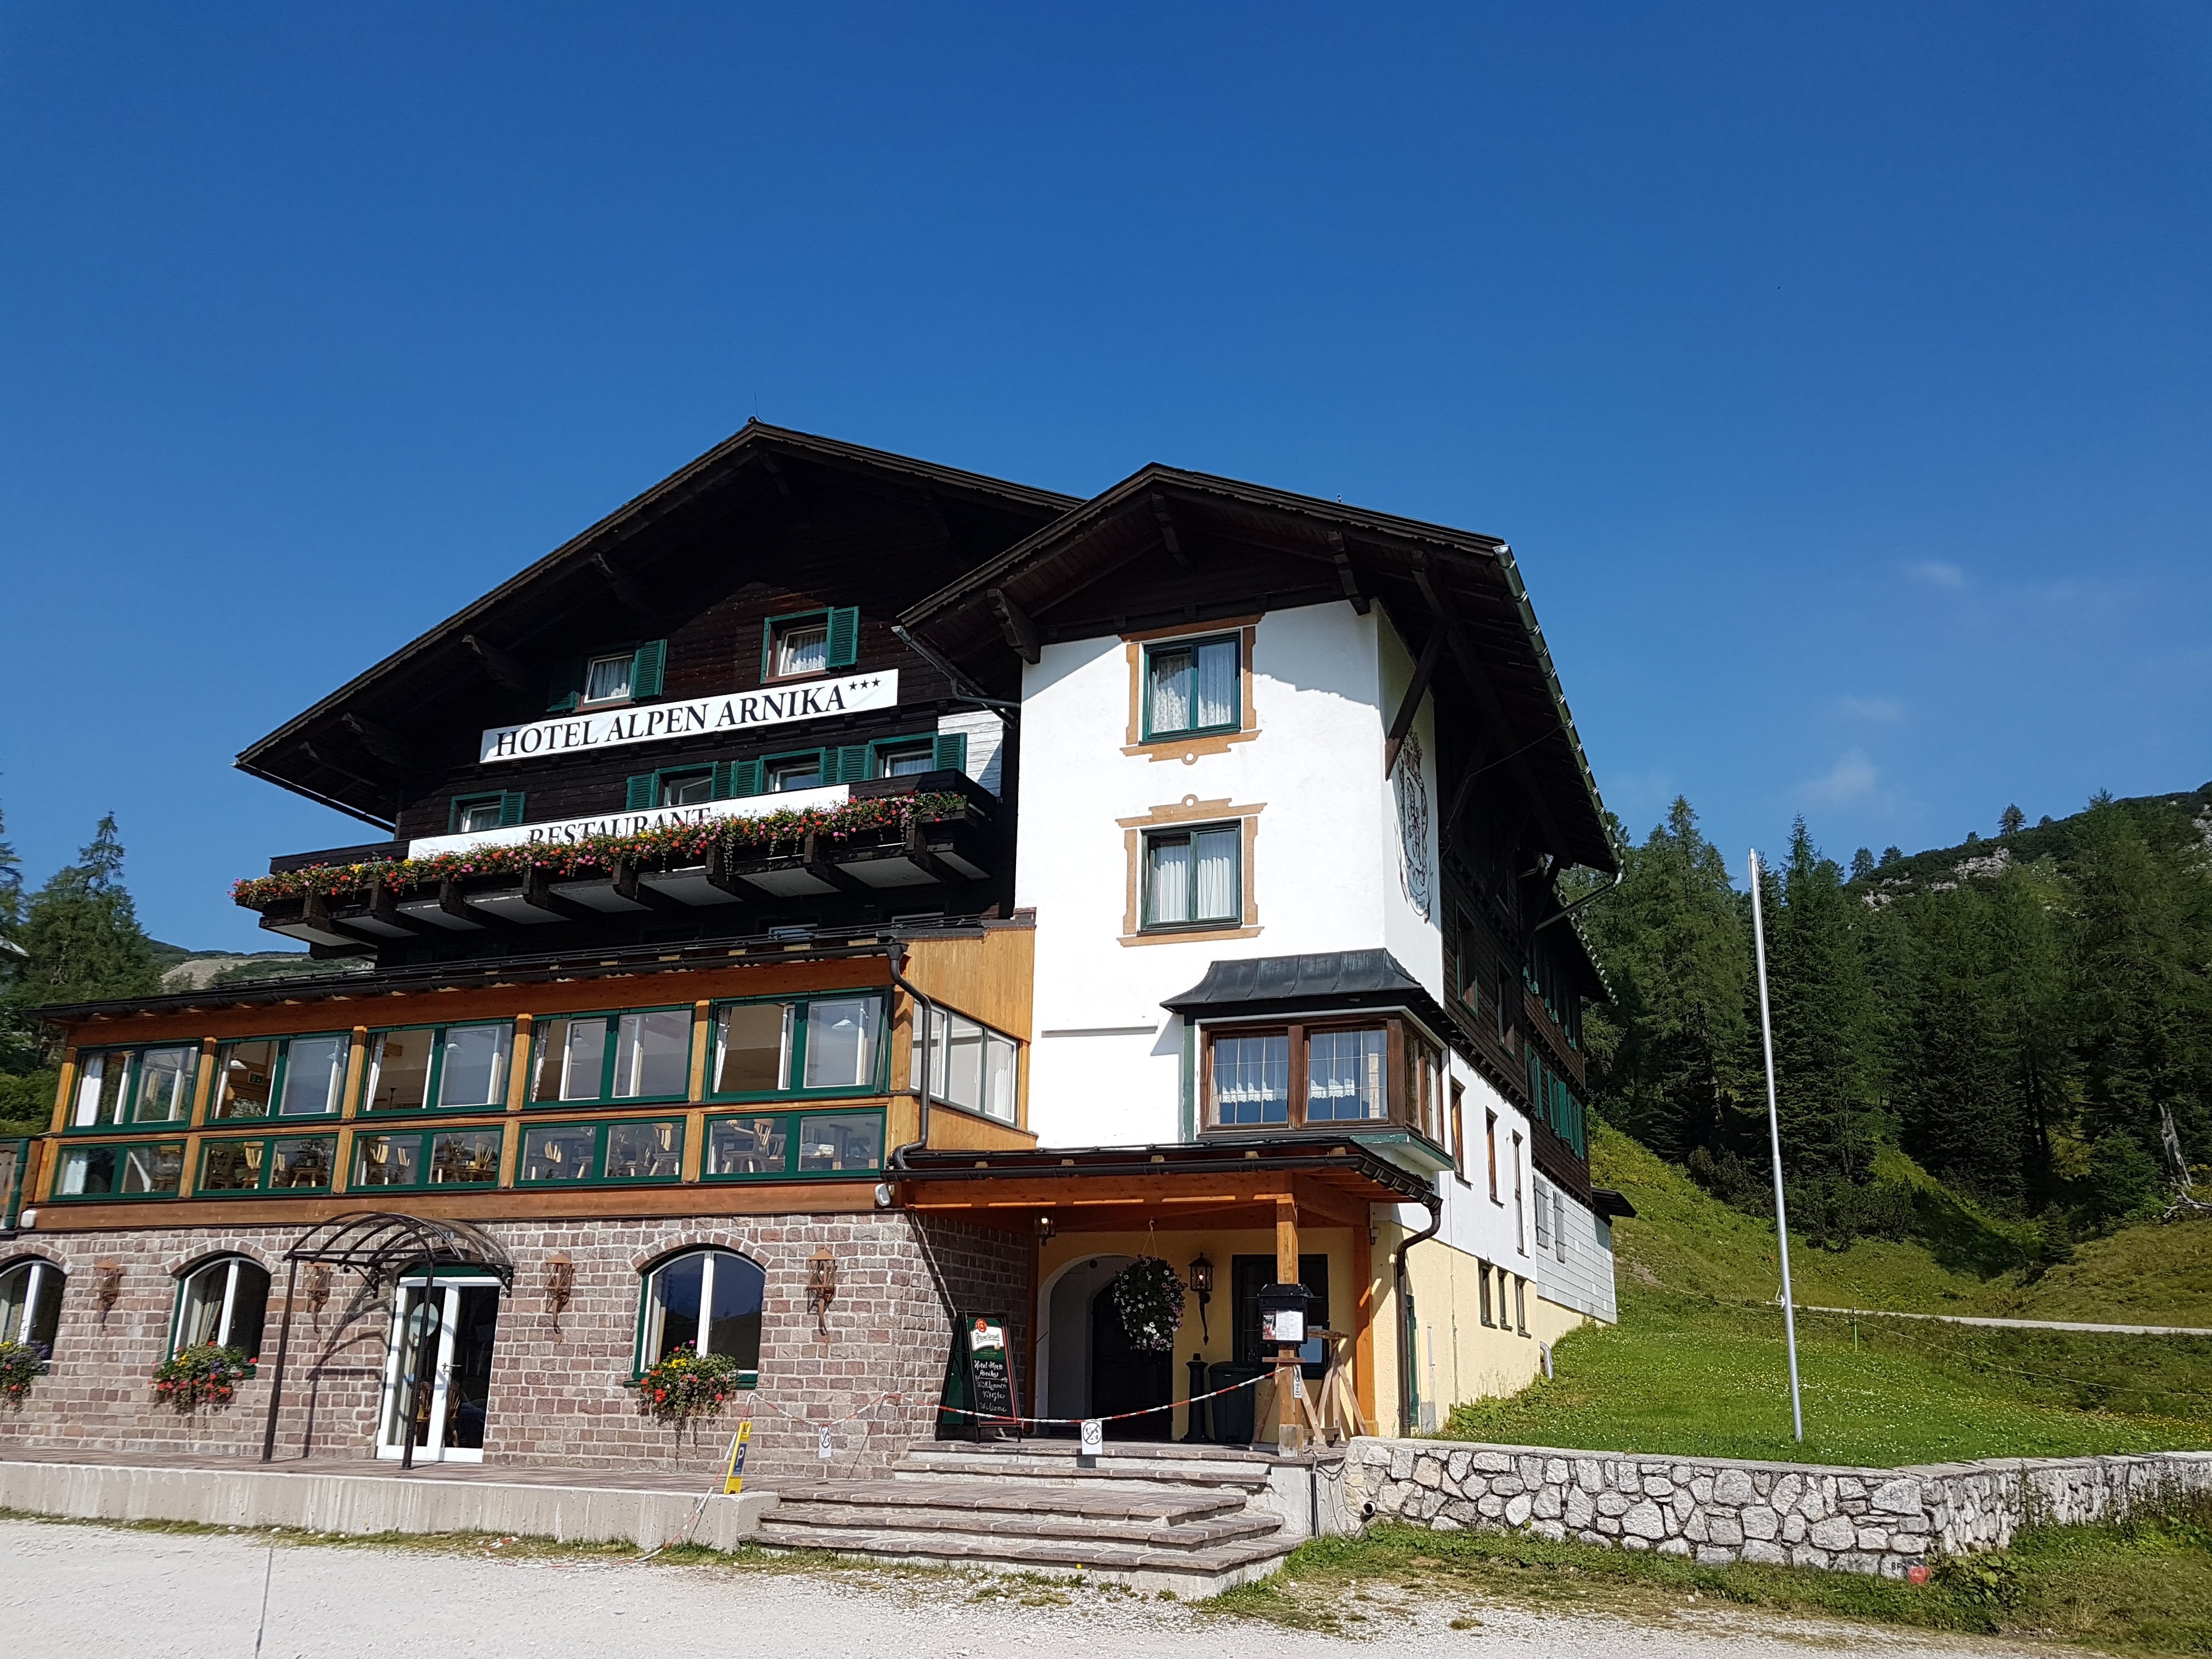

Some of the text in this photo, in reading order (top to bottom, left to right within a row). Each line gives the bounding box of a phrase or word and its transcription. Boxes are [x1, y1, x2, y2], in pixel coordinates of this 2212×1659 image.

[494, 684, 847, 757] HOTEL ALPEN ARNIKA
[974, 1360, 988, 1370] Hotel
[980, 1403, 1007, 1412] Welcome
[736, 1447, 744, 1465] P
